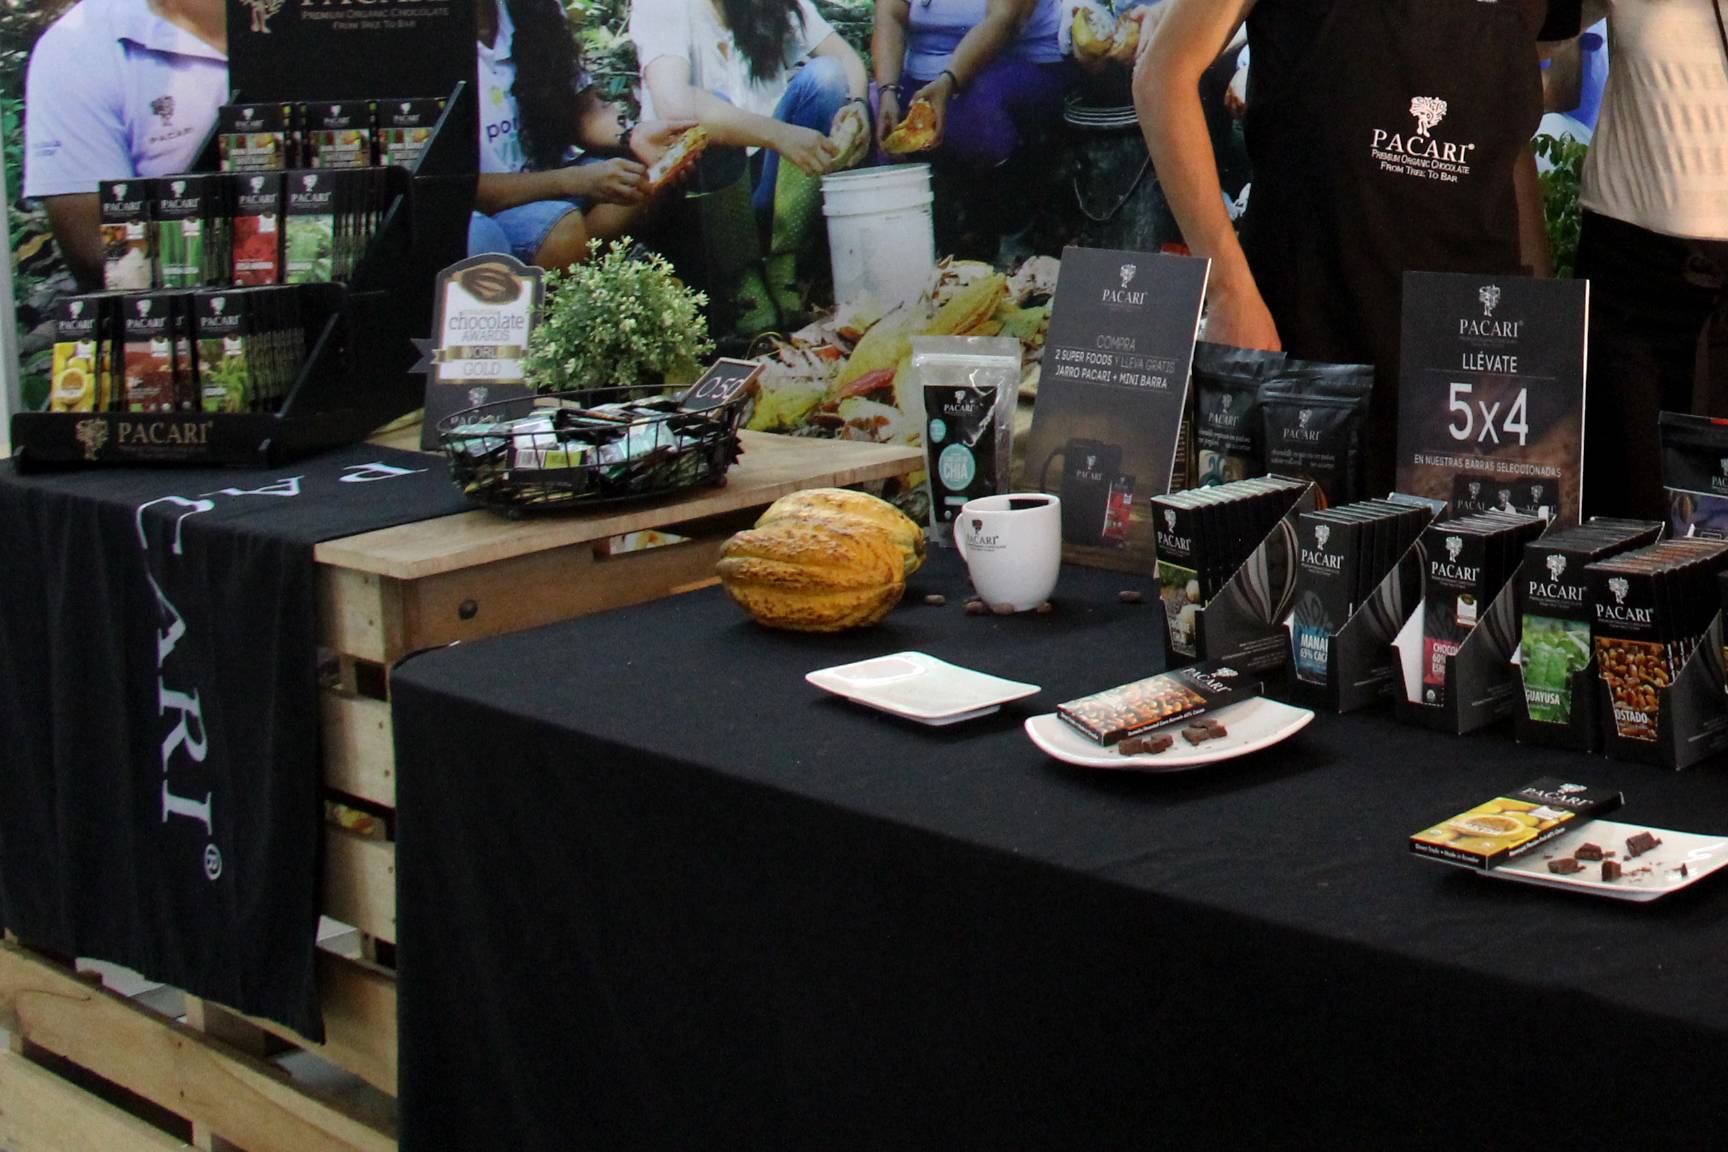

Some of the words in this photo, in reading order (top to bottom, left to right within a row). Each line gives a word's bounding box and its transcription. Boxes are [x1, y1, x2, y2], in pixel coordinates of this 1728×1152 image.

[1370, 128, 1467, 164] PACARI
[1371, 149, 1402, 163] PREMIUM
[1401, 155, 1431, 169] ORGANIC
[1431, 161, 1471, 175] CHOCOLATE
[1380, 162, 1404, 174] FROM
[1405, 165, 1426, 178] TREE
[1440, 173, 1458, 183] BAR
[1102, 289, 1145, 305] PACARI
[450, 312, 525, 330] chocolate
[1459, 319, 1519, 337] PACARI
[462, 330, 510, 342] AWARDS
[1096, 334, 1137, 352] COMPRA
[463, 362, 500, 375] GOLD
[1061, 351, 1084, 362] SUPER
[1085, 353, 1112, 366] FOODS
[1147, 359, 1176, 374] GRATIS
[1462, 351, 1518, 373] LLÉVATE
[1055, 365, 1080, 378] JARRO
[1081, 368, 1112, 382] PACARI
[1119, 373, 1139, 385] MINI
[1140, 375, 1168, 389] BARRA
[1449, 382, 1529, 446] 5x4
[118, 421, 209, 443] PACARI
[943, 464, 968, 480] CHIA
[1414, 454, 1424, 464] EN
[1425, 456, 1463, 469] NUESTRAS
[1465, 459, 1495, 472] BARRAS
[1496, 462, 1562, 478] SELECCIONADAS
[1157, 530, 1191, 552] PACARI
[1301, 549, 1342, 569] PACARI
[1432, 560, 1477, 582] PACARI
[1529, 581, 1583, 601] PACARI
[1596, 603, 1651, 623] PACARI
[1525, 689, 1561, 706] GUAYUSA
